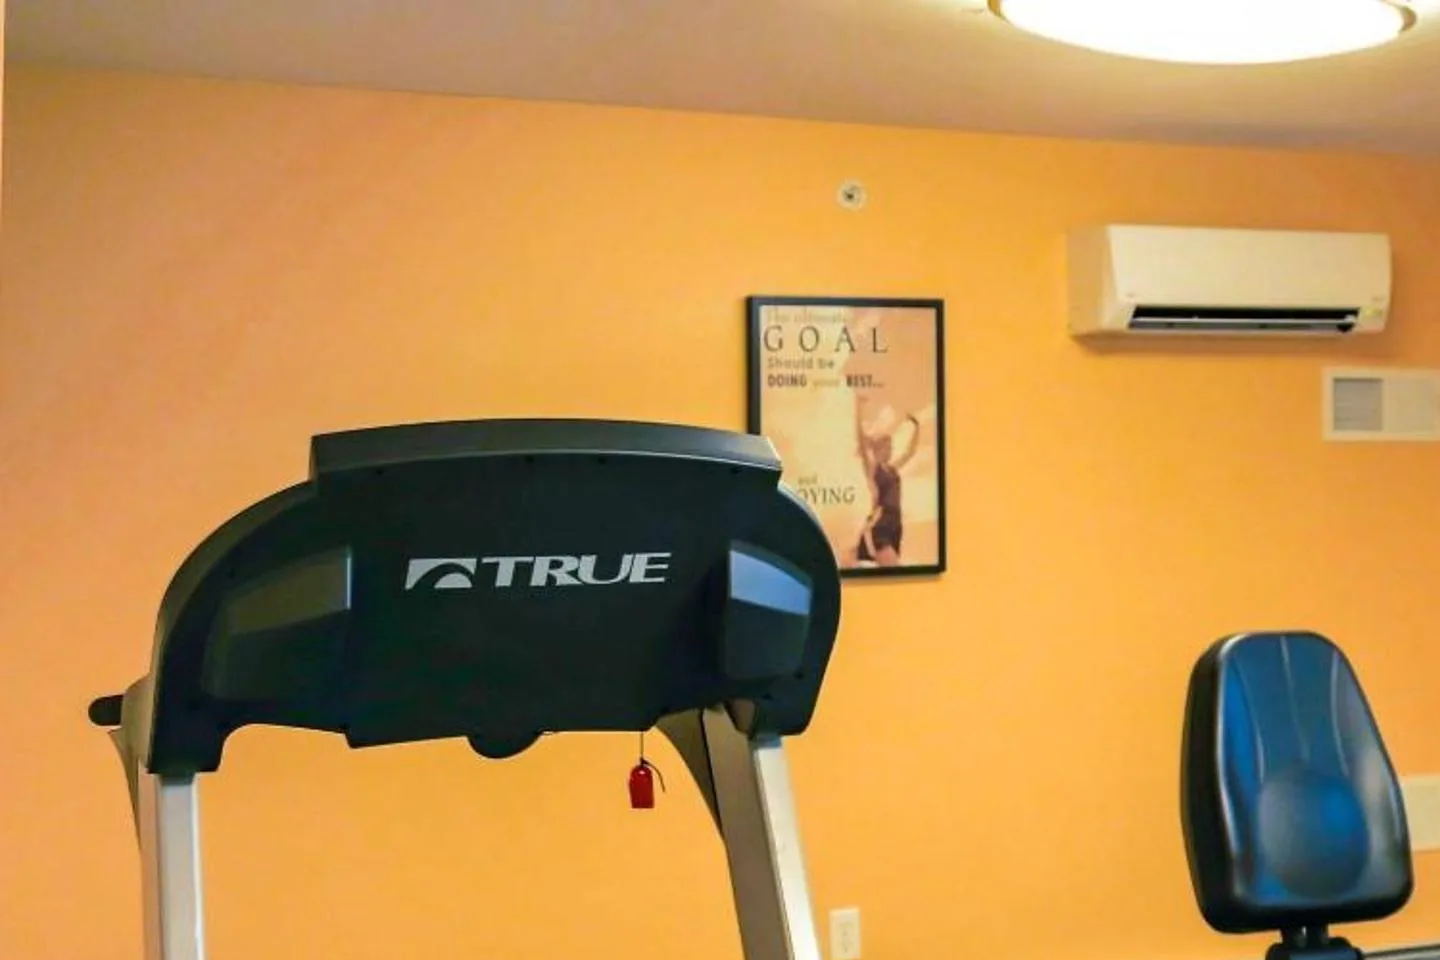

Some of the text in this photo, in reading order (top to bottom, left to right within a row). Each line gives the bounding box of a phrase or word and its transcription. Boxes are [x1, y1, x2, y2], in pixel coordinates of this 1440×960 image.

[763, 325, 888, 353] GOAL
[767, 357, 814, 370] Should
[767, 373, 808, 388] DOING
[481, 552, 671, 587] TRUE
